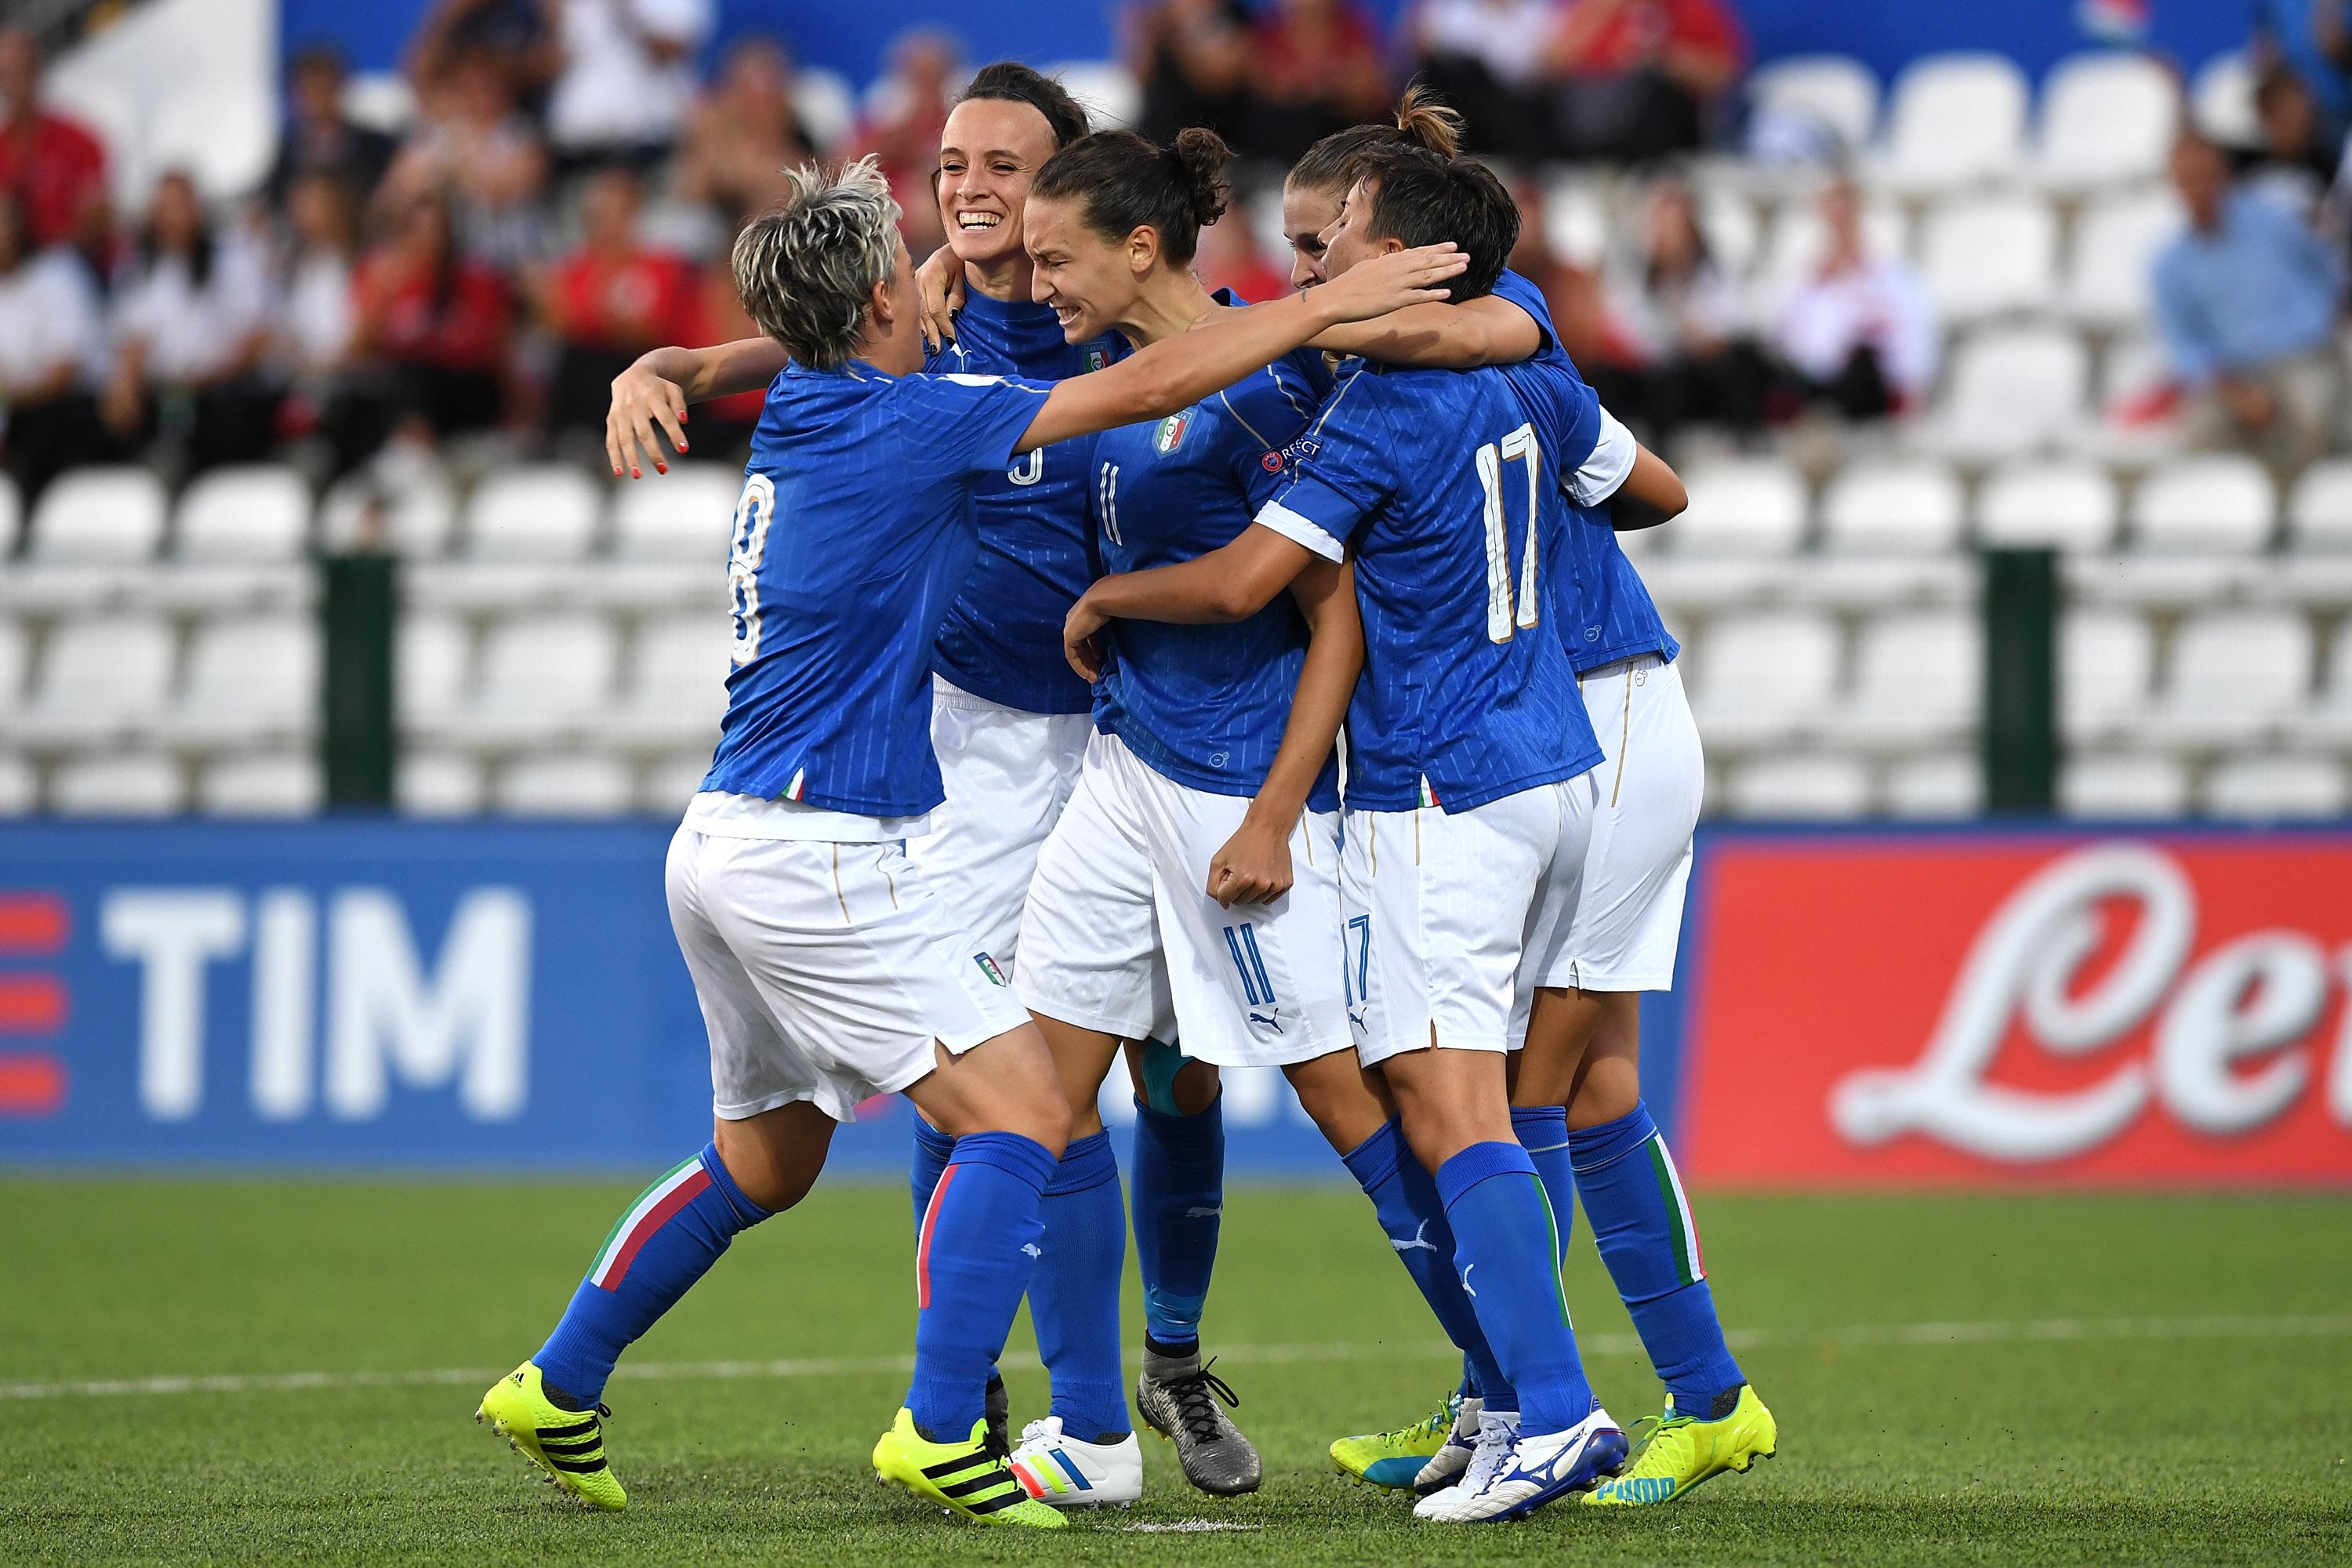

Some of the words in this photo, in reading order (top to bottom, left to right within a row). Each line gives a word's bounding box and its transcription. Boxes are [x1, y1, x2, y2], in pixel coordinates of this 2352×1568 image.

[1100, 461, 1123, 546] 11
[1476, 422, 1540, 644] 17
[728, 473, 775, 666] 8
[100, 887, 533, 1121] TIM
[1223, 923, 1276, 1006] 11
[1341, 914, 1370, 1007] 17
[1597, 1477, 1675, 1504] PUMA
